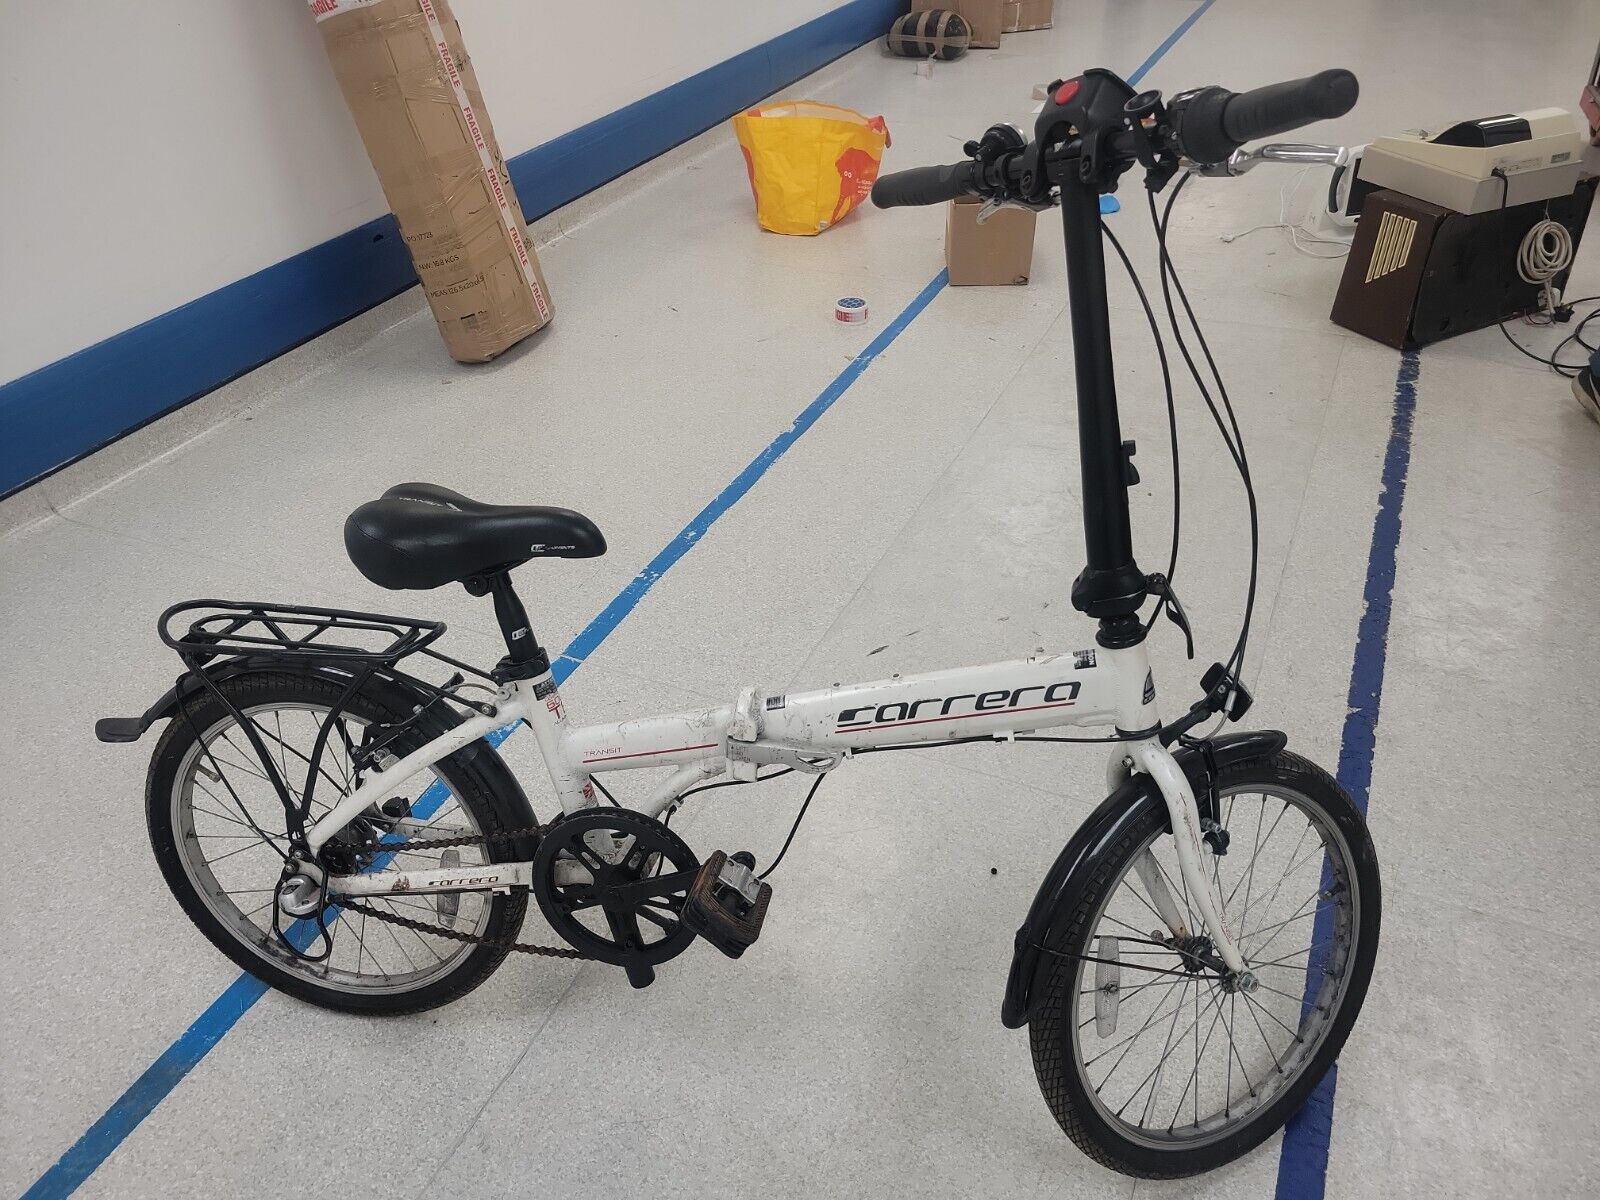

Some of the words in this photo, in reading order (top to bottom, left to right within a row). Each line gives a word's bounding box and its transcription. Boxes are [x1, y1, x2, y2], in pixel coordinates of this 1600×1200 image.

[438, 42, 461, 88] FRAGILE
[463, 106, 485, 151] FRAGILE
[488, 168, 507, 210] FRAGILE
[510, 226, 528, 267] FRAGILE
[531, 282, 549, 321] FRAGILE
[837, 681, 1082, 728] carrera
[584, 747, 622, 756] TRANSIT
[428, 876, 499, 886] carrera
